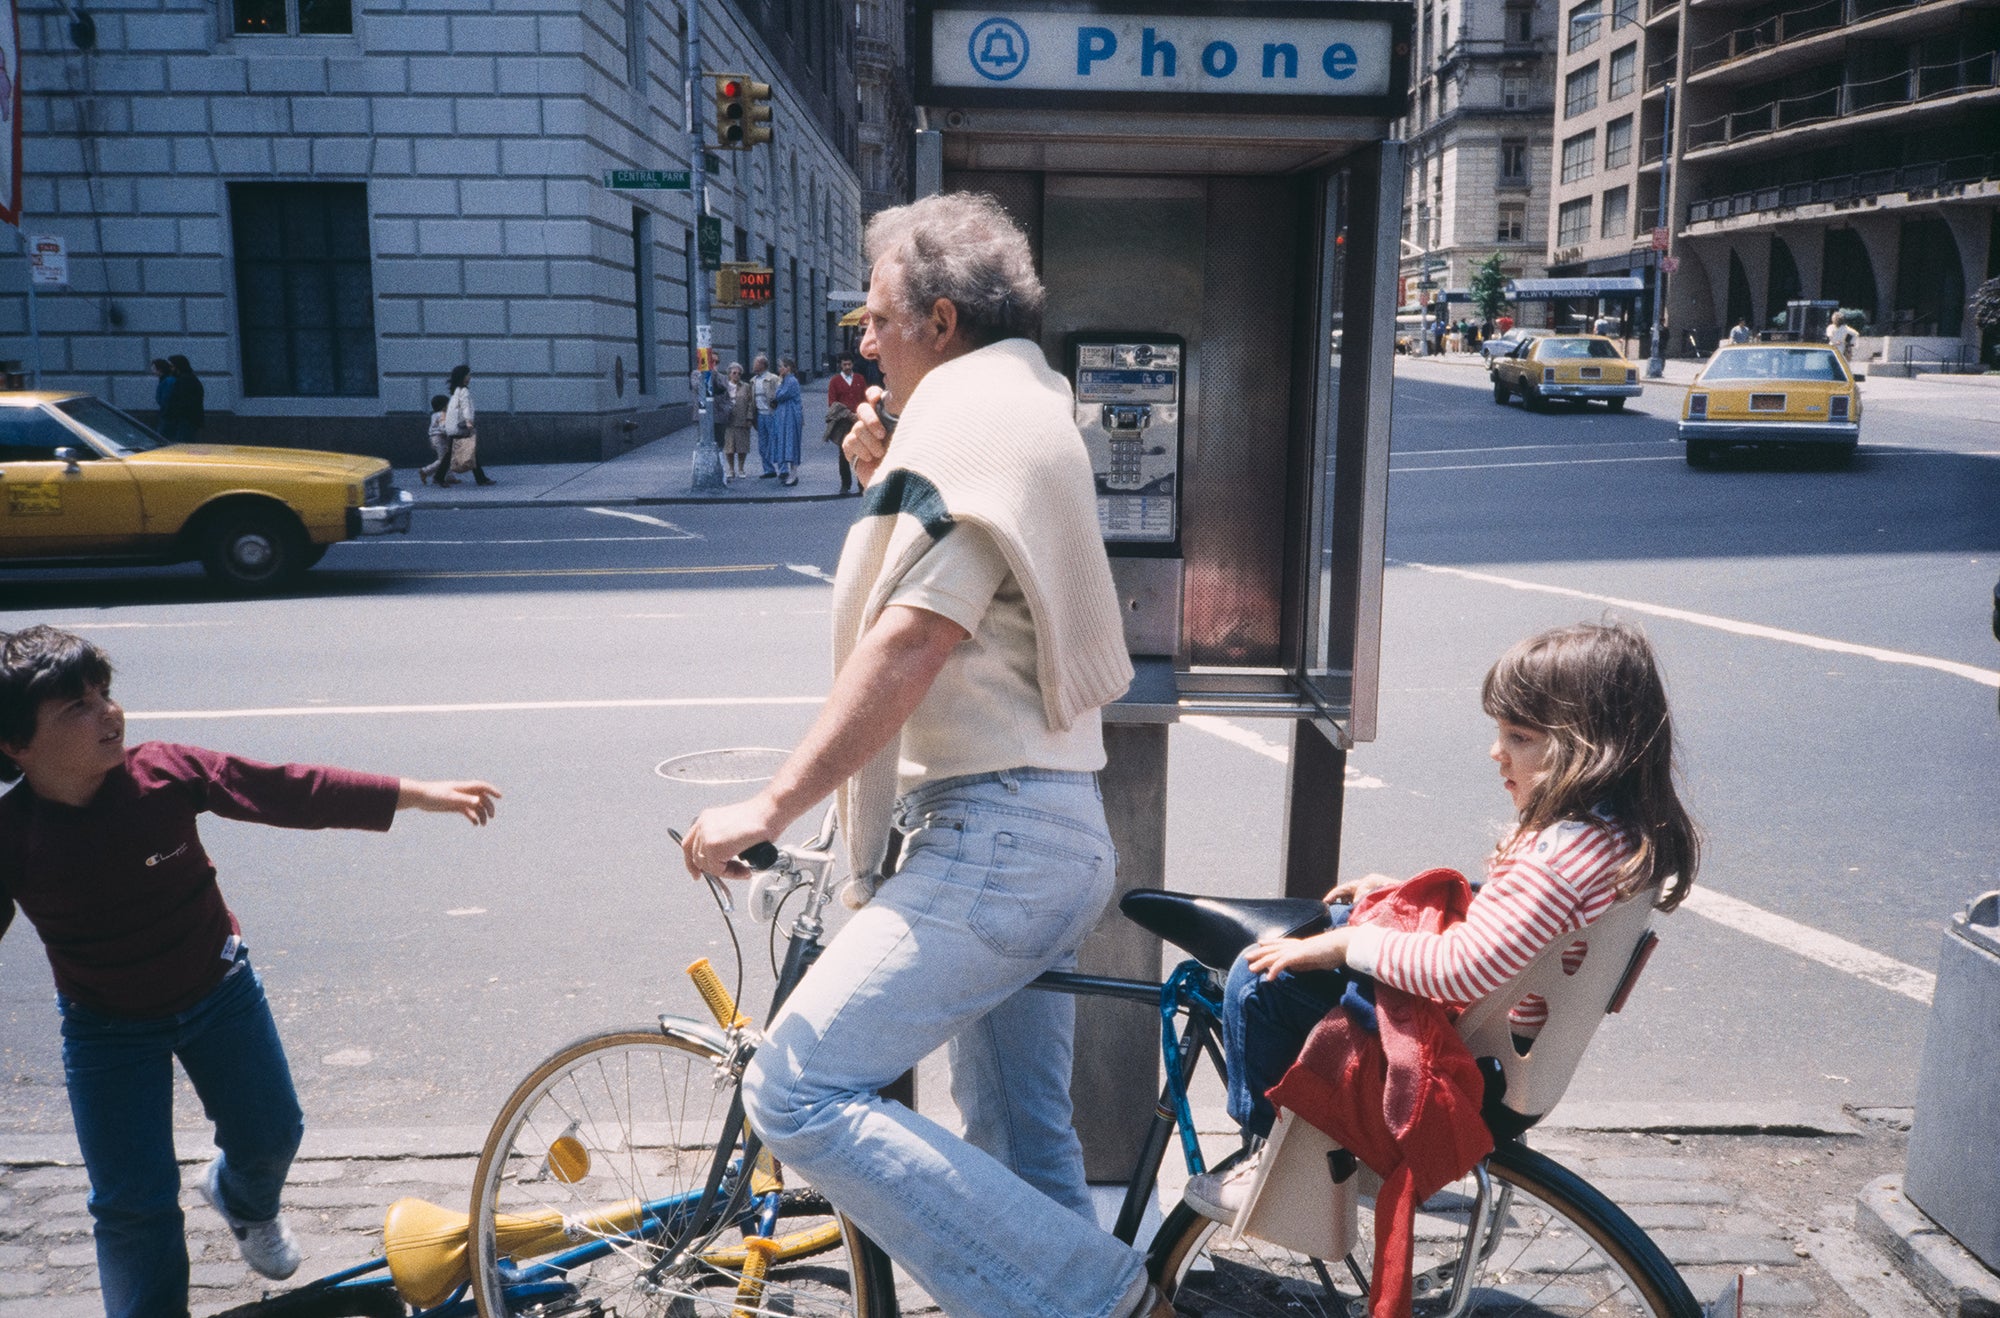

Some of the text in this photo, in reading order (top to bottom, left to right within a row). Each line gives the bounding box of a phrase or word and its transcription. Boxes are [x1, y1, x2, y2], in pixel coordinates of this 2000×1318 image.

[1077, 26, 1358, 80] Phone
[617, 171, 685, 182] CENTRAL PARK
[740, 274, 770, 285] DONT
[741, 289, 770, 300] WALK
[1552, 289, 1600, 298] PHARMACY
